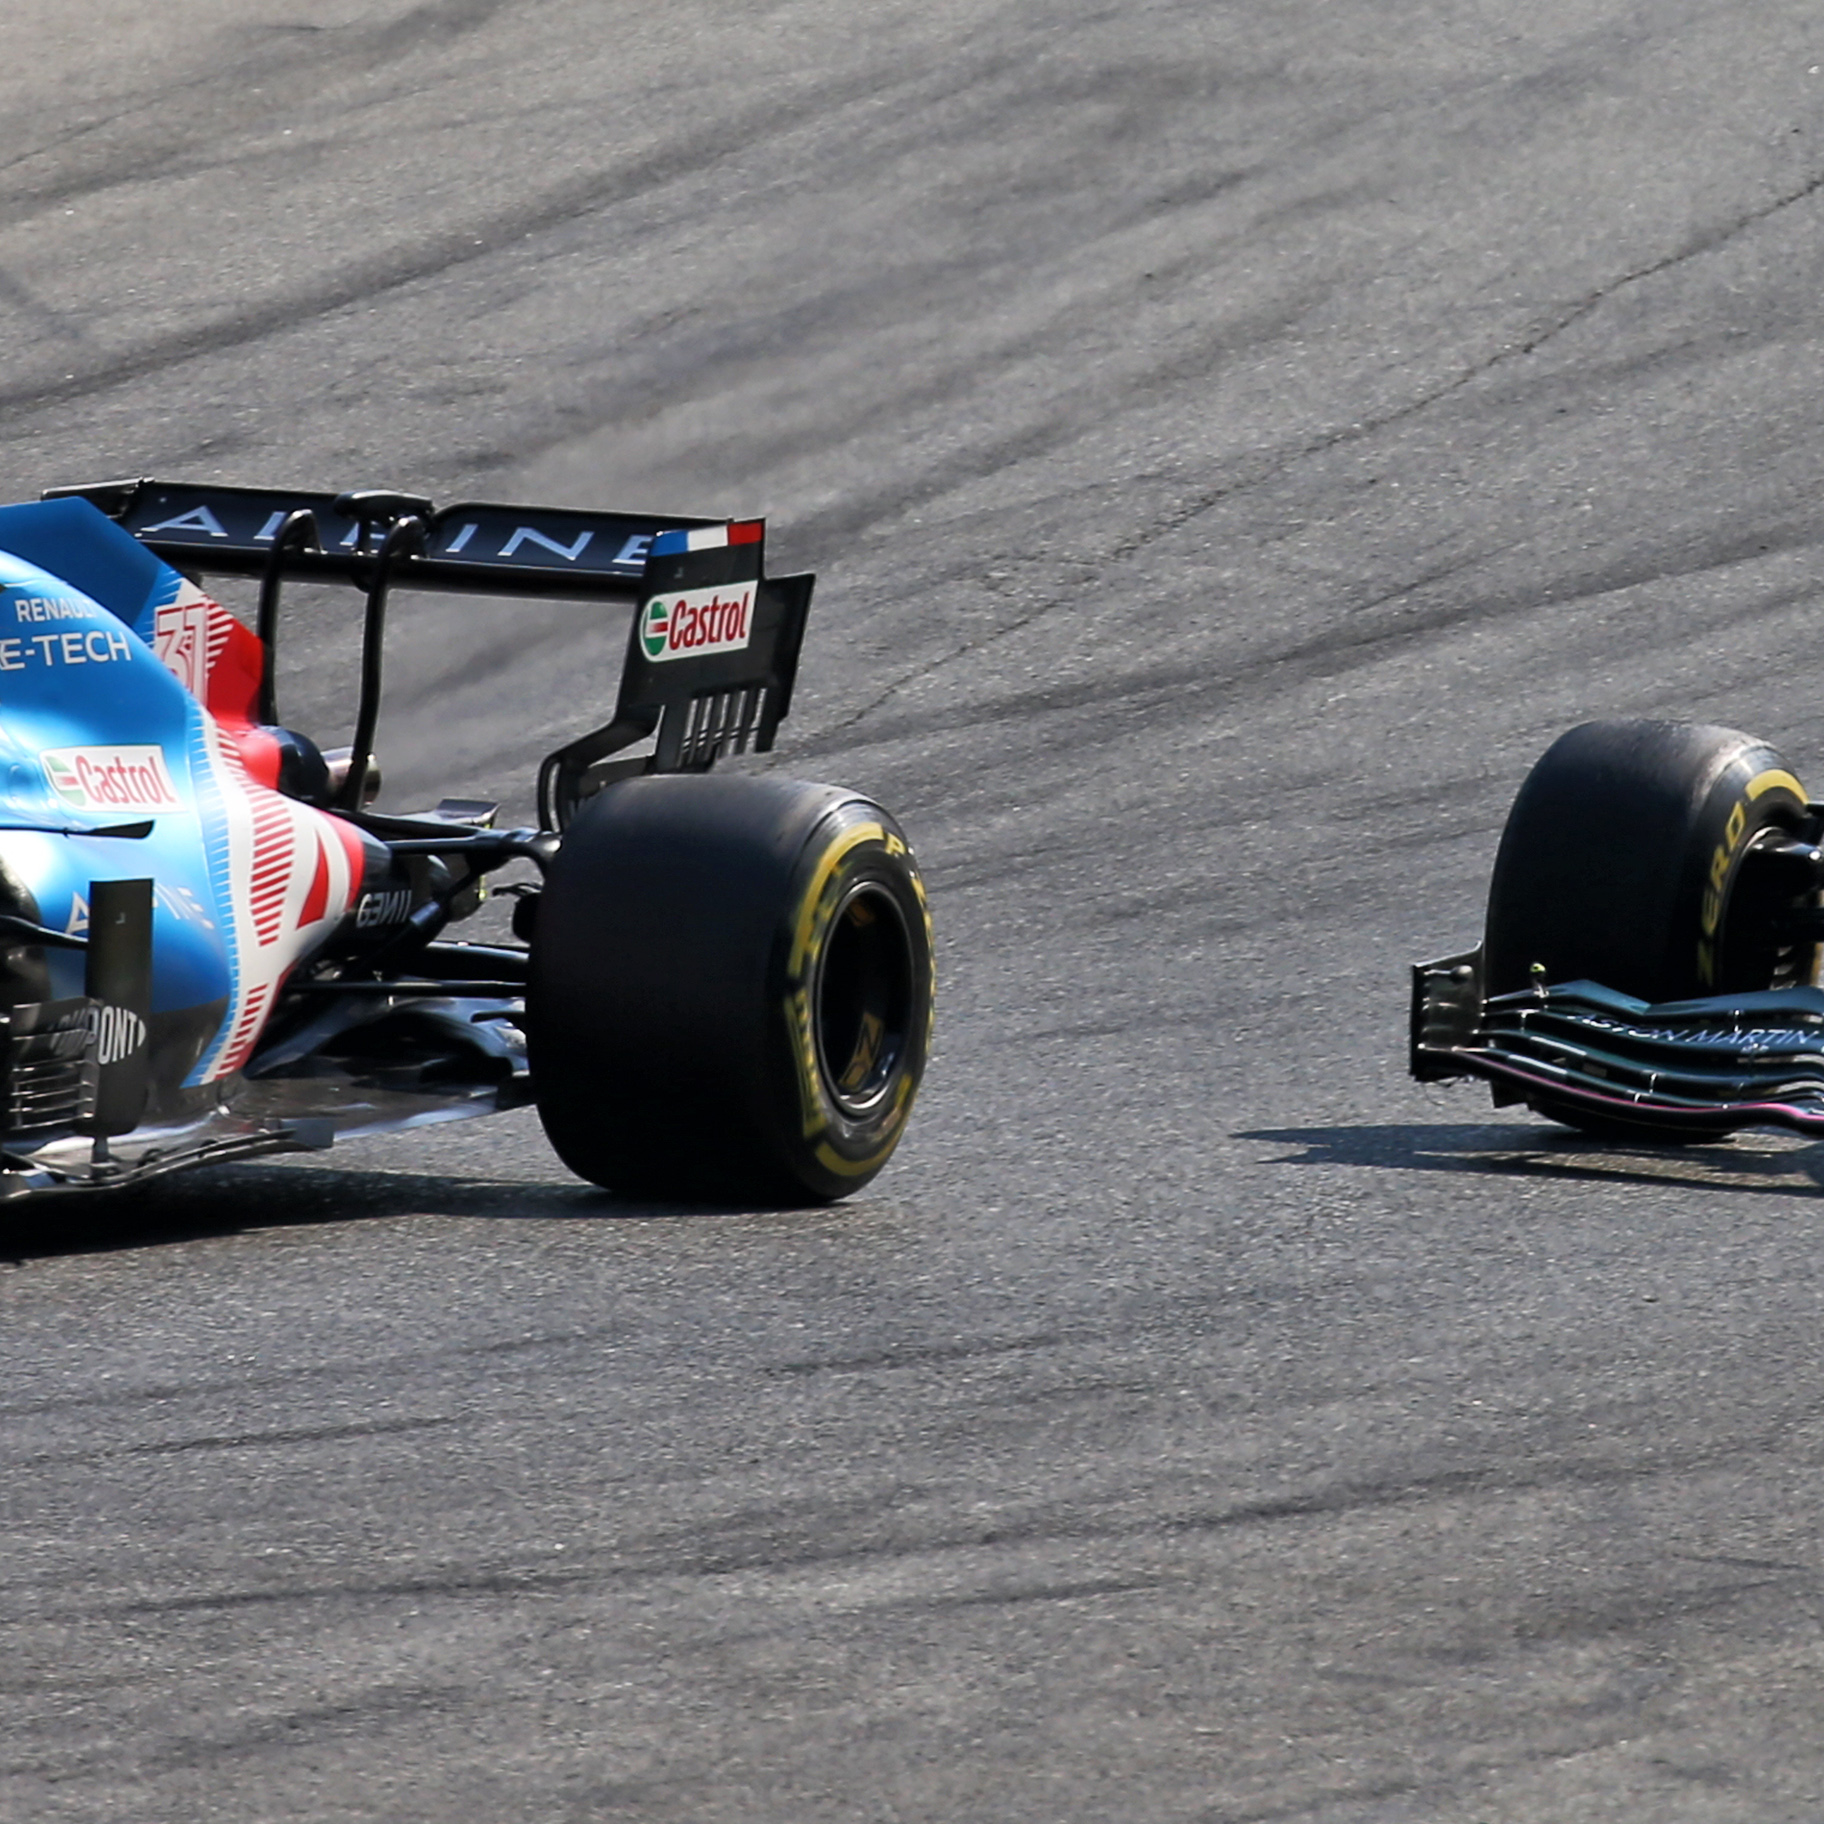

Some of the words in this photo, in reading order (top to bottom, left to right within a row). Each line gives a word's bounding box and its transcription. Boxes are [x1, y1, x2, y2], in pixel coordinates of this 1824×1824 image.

[669, 597, 750, 650] Castrol
[72, 754, 177, 805] Castrol
[1686, 1028, 1820, 1045] MARTIN
